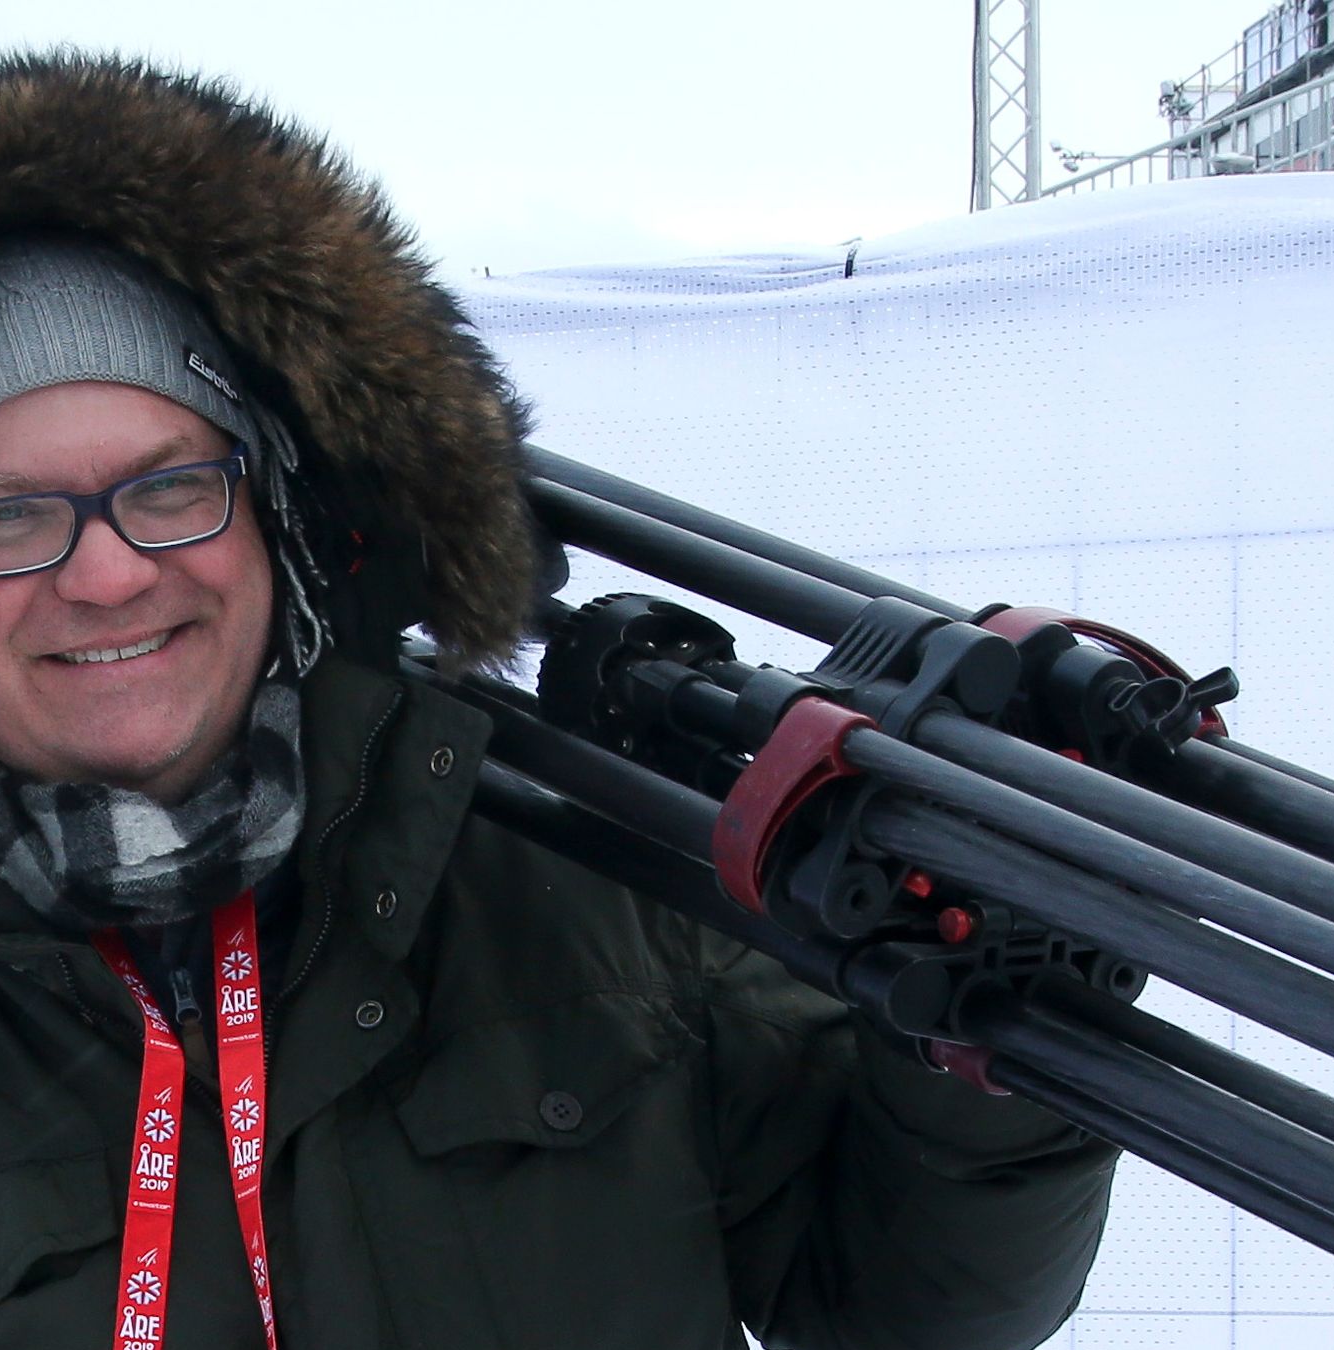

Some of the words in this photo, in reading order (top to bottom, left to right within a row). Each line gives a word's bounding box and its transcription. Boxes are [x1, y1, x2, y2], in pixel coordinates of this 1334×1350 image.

[220, 985, 259, 1015] ÅRE
[226, 1012, 255, 1027] 2019
[136, 1143, 174, 1178] ÅRE
[231, 1135, 261, 1168] ÅRE
[139, 1177, 170, 1192] 2019
[120, 1305, 160, 1340] ÅRE
